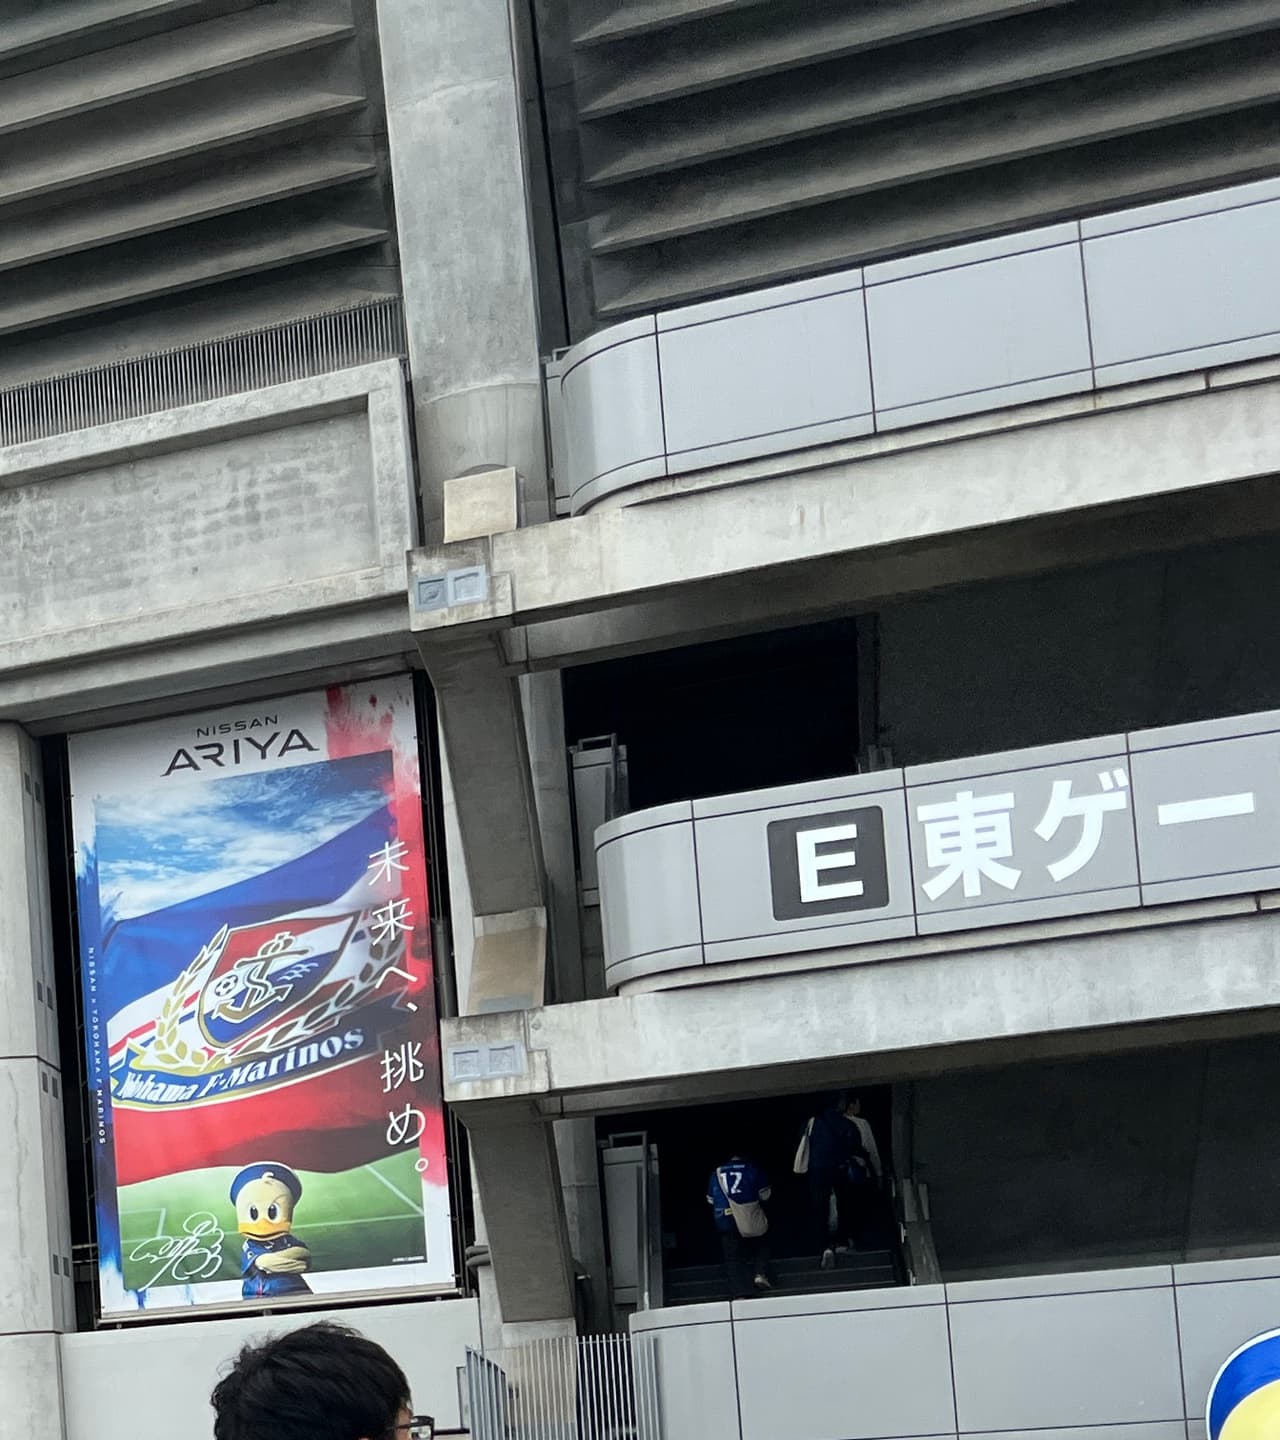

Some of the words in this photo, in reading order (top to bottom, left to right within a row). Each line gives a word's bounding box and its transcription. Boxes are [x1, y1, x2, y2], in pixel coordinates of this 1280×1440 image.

[160, 728, 320, 777] ARIYA
[196, 714, 278, 738] NISSAN
[795, 823, 864, 903] E
[915, 767, 1256, 902] 東ゲー
[367, 839, 429, 1174] 未来へ、挑め。
